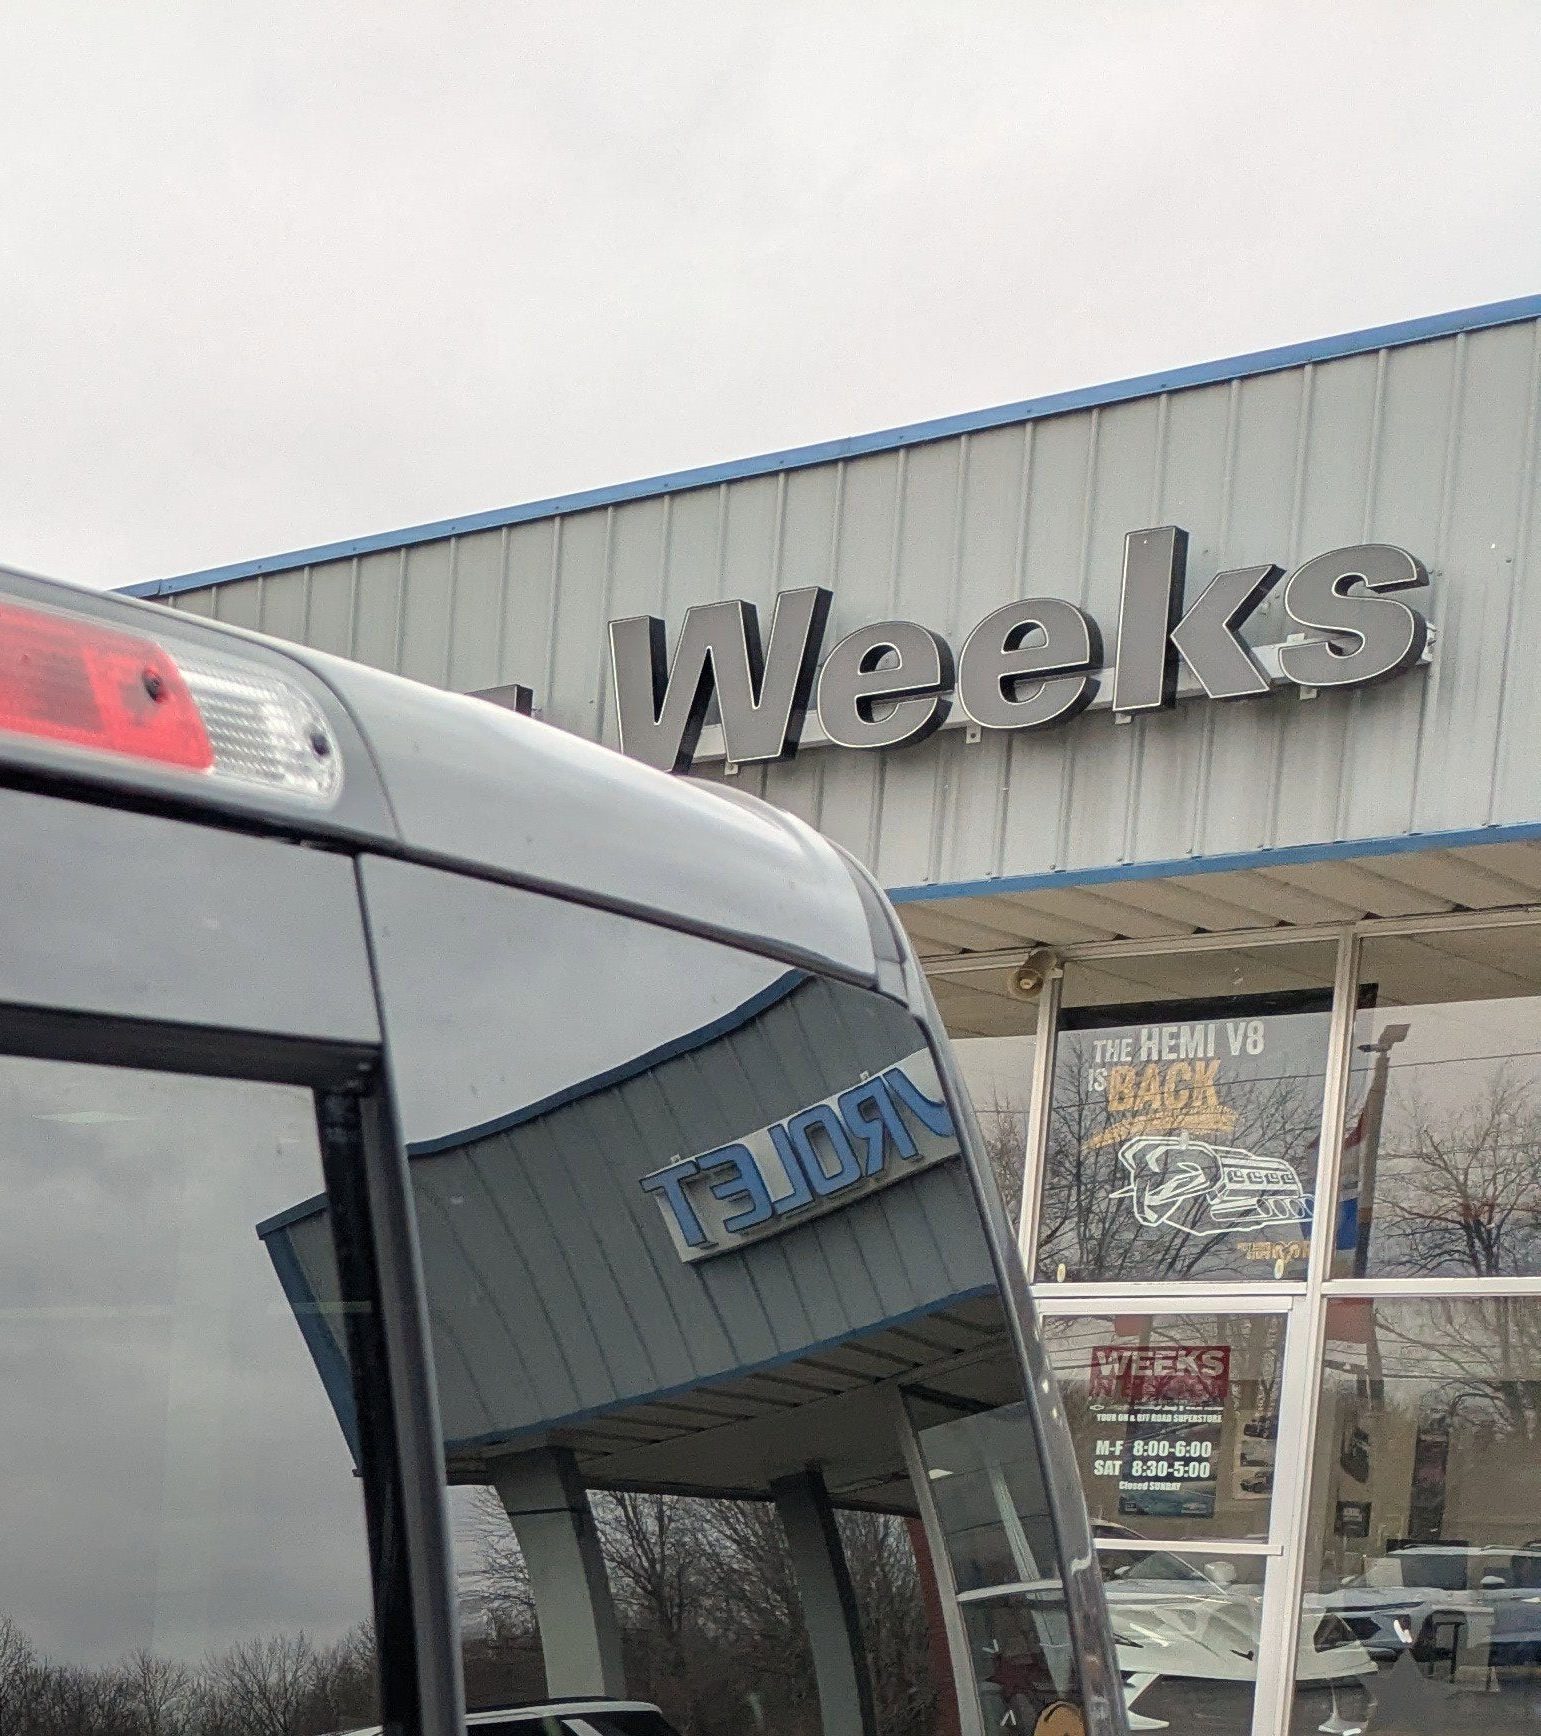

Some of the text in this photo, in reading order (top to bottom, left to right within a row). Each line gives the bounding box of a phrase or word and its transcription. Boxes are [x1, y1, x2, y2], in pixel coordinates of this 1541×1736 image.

[607, 525, 1430, 772] Weeks
[1093, 1020, 1265, 1063] THE HEMI V8
[1088, 1060, 1221, 1111] IS BACK
[1096, 1350, 1225, 1376] WEEKS
[1095, 1440, 1212, 1457] M-F 8:00-6:00
[1094, 1460, 1211, 1478] SAT 8:30-5:00
[1118, 1481, 1149, 1490] Closed
